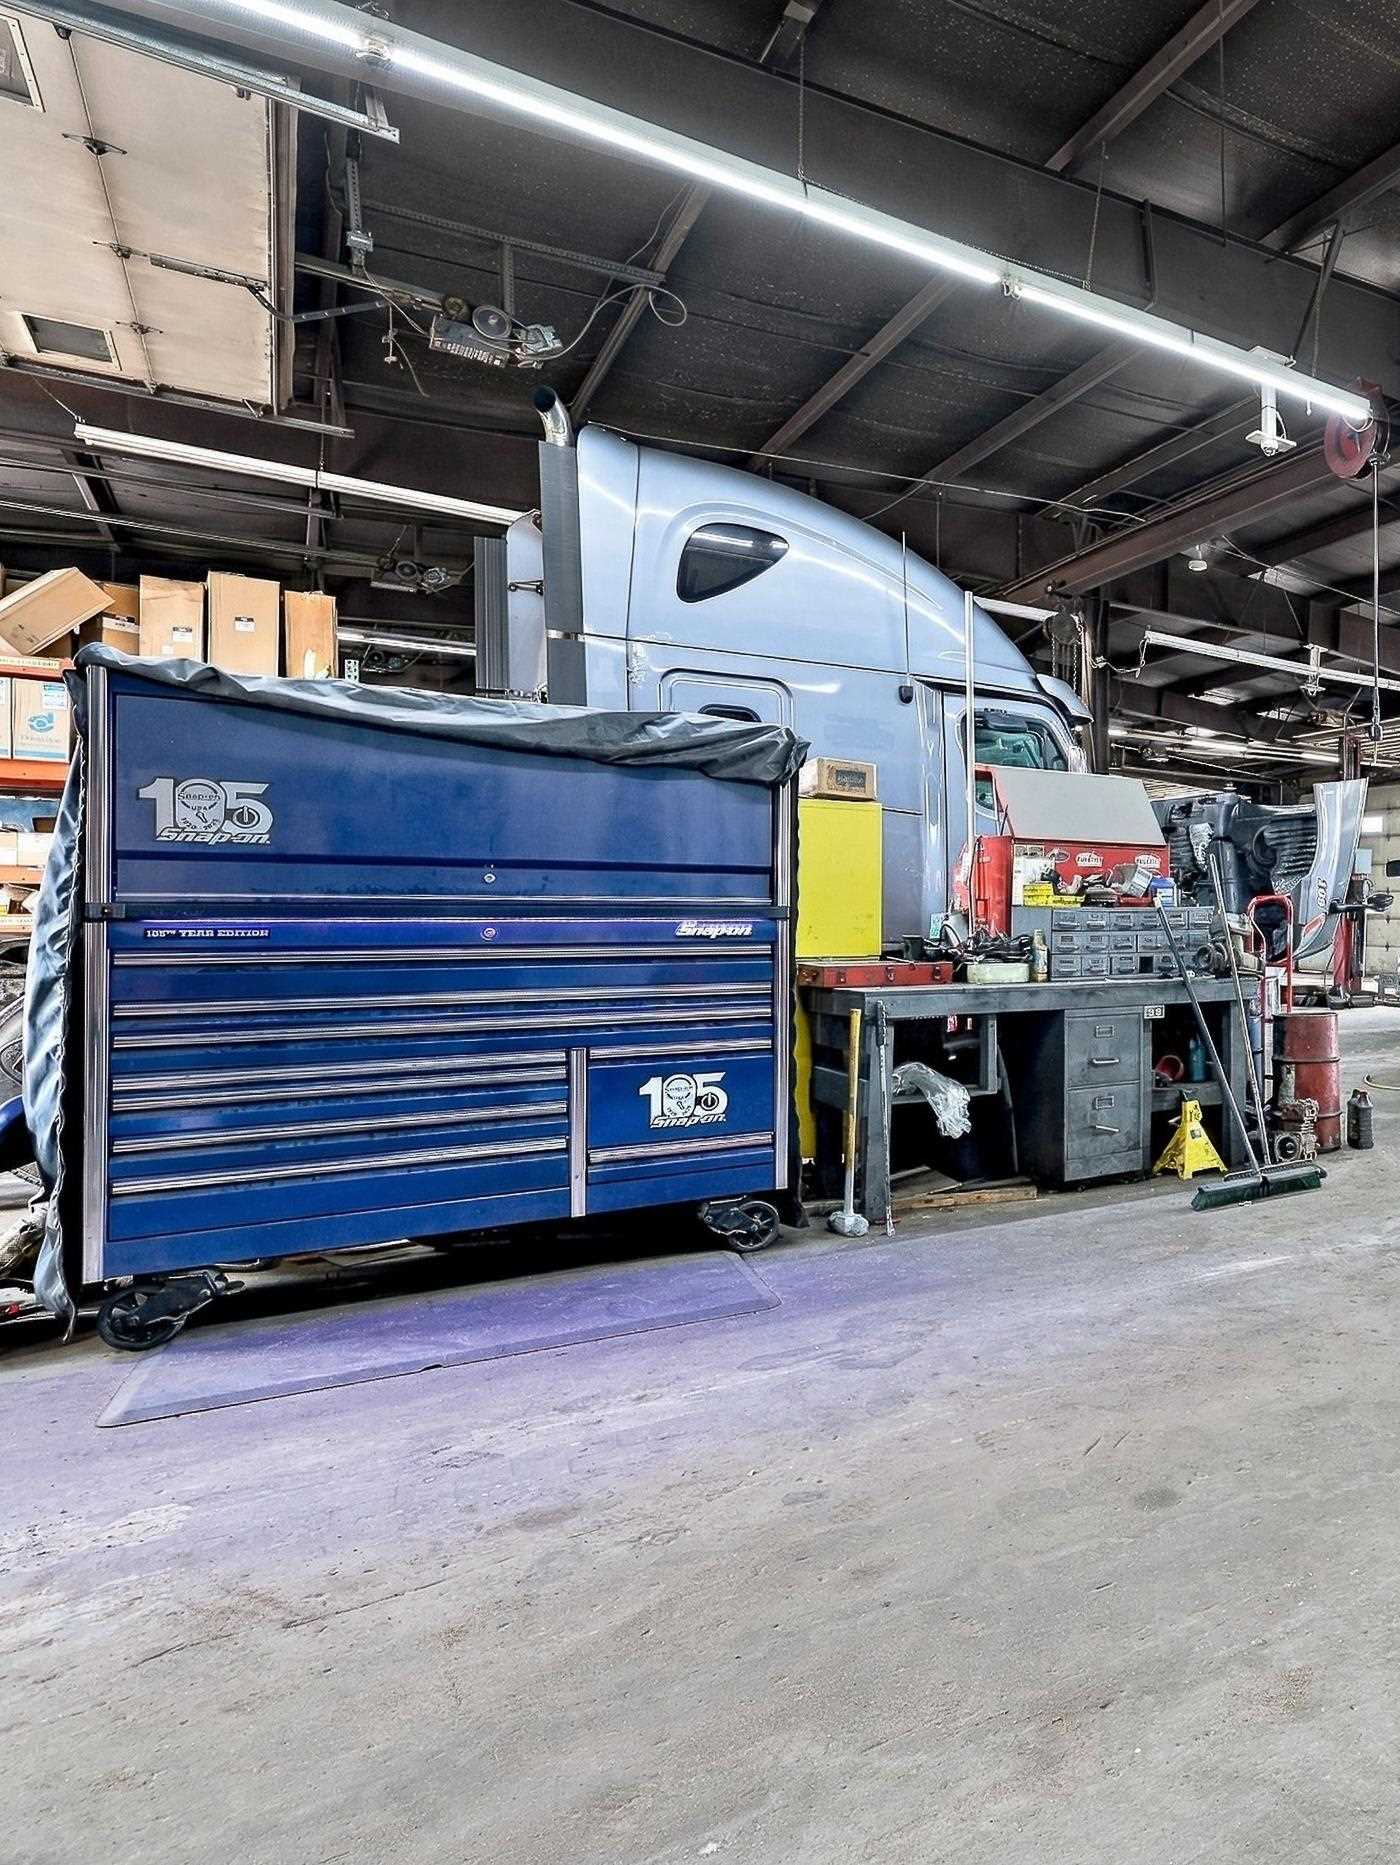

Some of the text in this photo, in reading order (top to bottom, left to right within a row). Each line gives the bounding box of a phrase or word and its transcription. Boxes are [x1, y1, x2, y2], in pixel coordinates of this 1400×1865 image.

[138, 778, 274, 836] 105
[178, 929, 214, 937] YEAR
[217, 929, 269, 937] EDITION
[639, 1072, 728, 1124] 105
